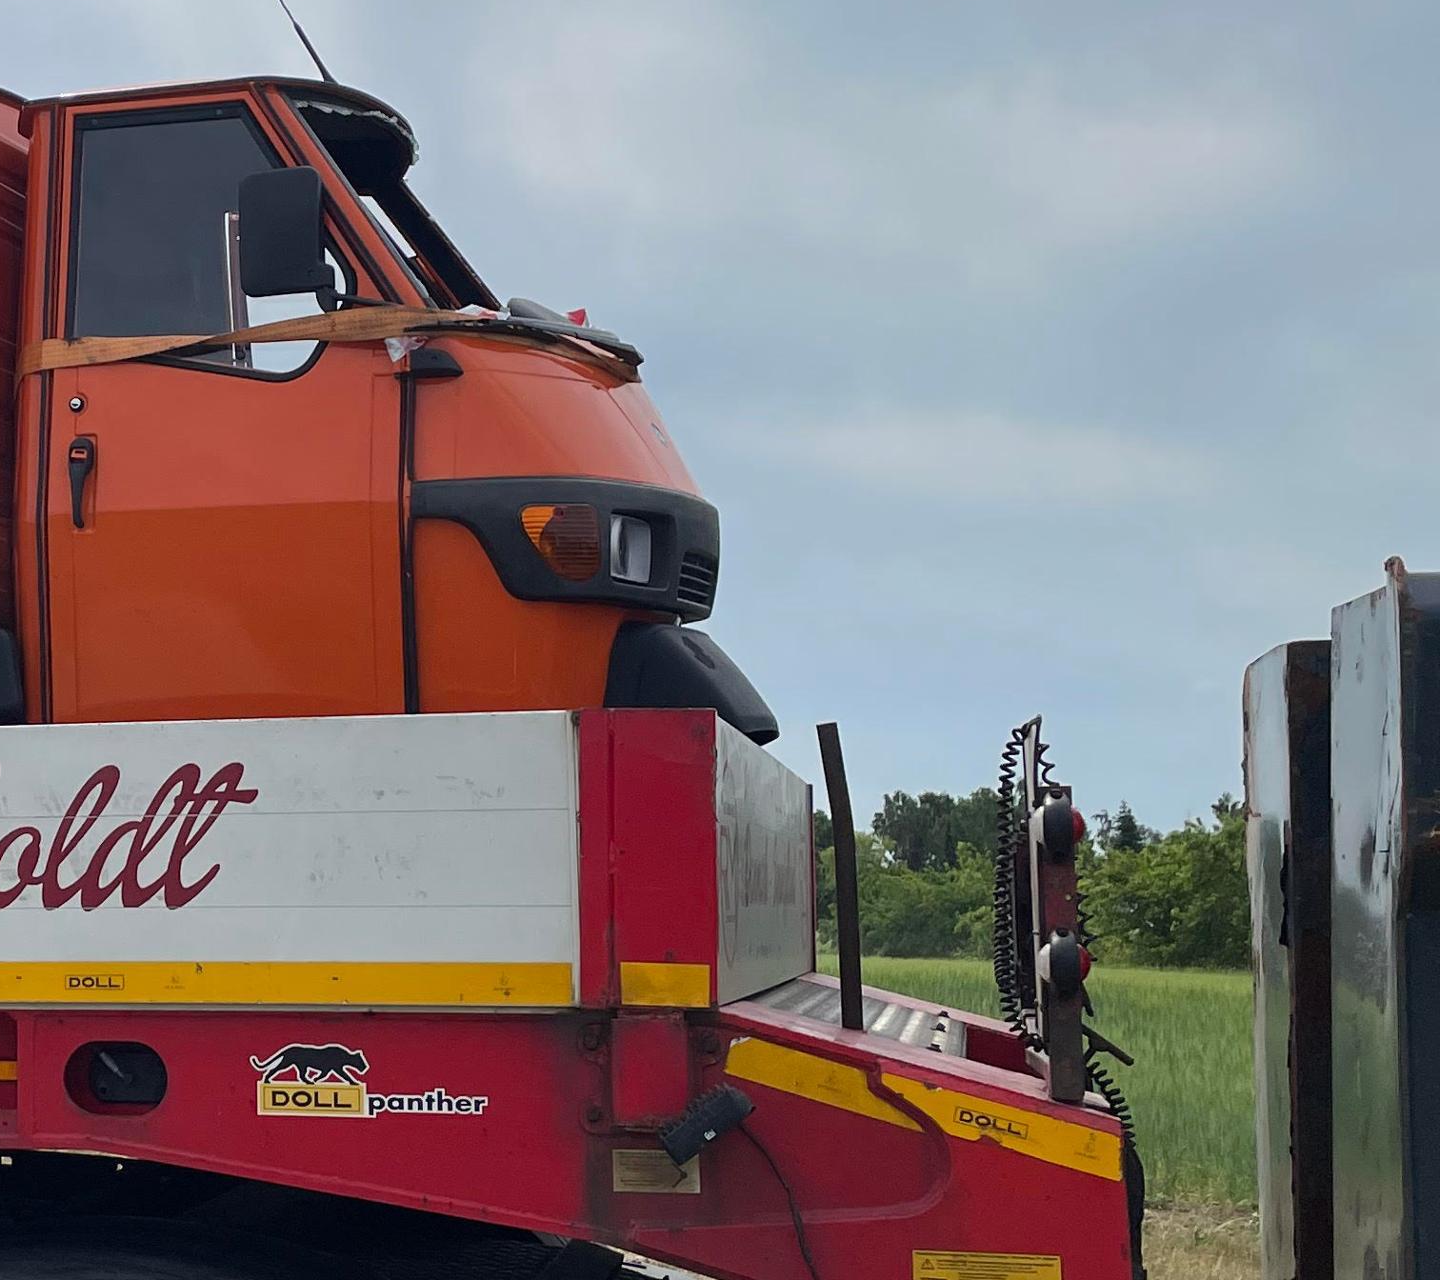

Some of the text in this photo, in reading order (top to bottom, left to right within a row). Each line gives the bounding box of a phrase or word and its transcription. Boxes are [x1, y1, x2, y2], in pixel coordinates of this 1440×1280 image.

[68, 976, 121, 988] DOLL
[271, 1090, 486, 1116] DOLL panther
[959, 1110, 1022, 1135] DOLL
